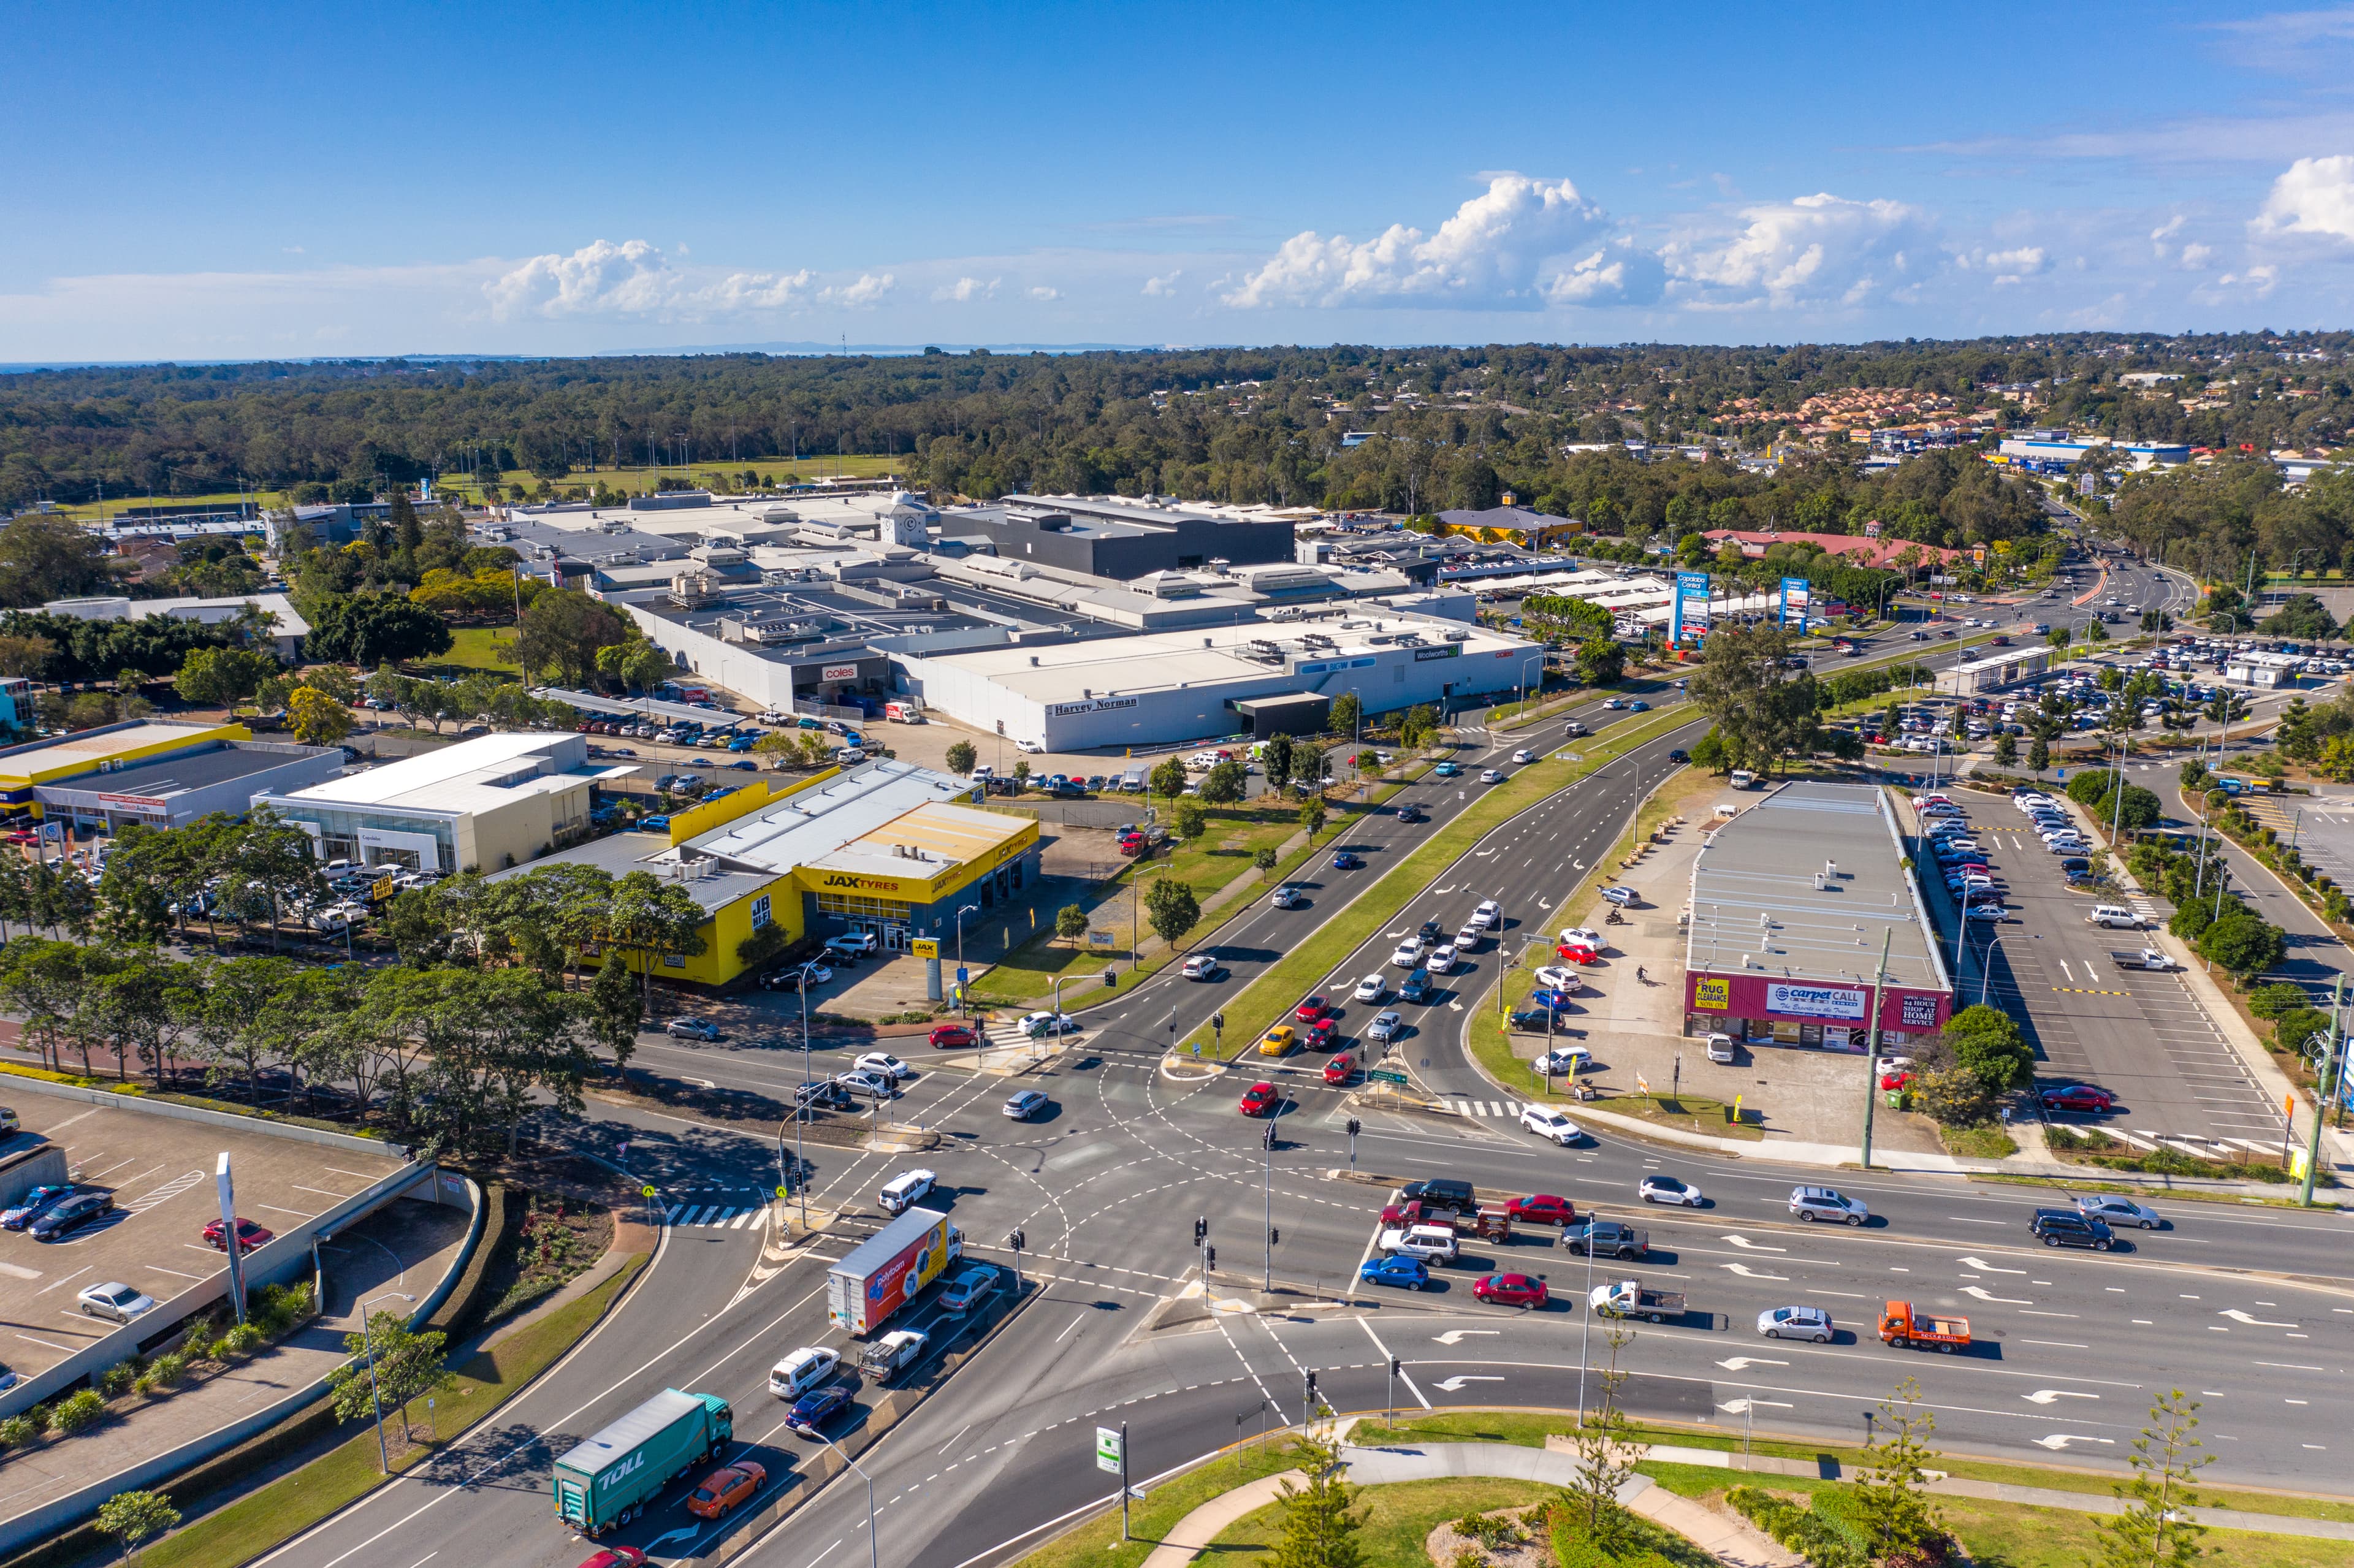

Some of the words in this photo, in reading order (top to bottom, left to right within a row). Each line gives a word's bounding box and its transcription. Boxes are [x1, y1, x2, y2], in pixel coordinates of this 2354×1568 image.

[1417, 649, 1449, 659] Woolworths
[1496, 650, 1514, 658] coles
[826, 668, 854, 679] coles
[1055, 704, 1092, 714] Harvey
[1097, 698, 1137, 709] Norman
[888, 709, 901, 718] coles
[996, 844, 1011, 862] JAX
[376, 877, 390, 891] JB
[824, 875, 861, 889] JAX
[859, 880, 899, 891] TYRES
[932, 877, 947, 893] JAX
[376, 886, 390, 897] HI-FI
[753, 895, 770, 916] JB
[753, 910, 771, 927] HI-FI
[1701, 984, 1723, 994] RUG
[1791, 989, 1831, 1000] carpet
[1832, 991, 1858, 1002] CALL
[1697, 992, 1726, 1002] CLEARANCE
[1903, 1012, 1935, 1021] HOME
[877, 1260, 905, 1288] polyfoam
[598, 1450, 644, 1491] TOLL
